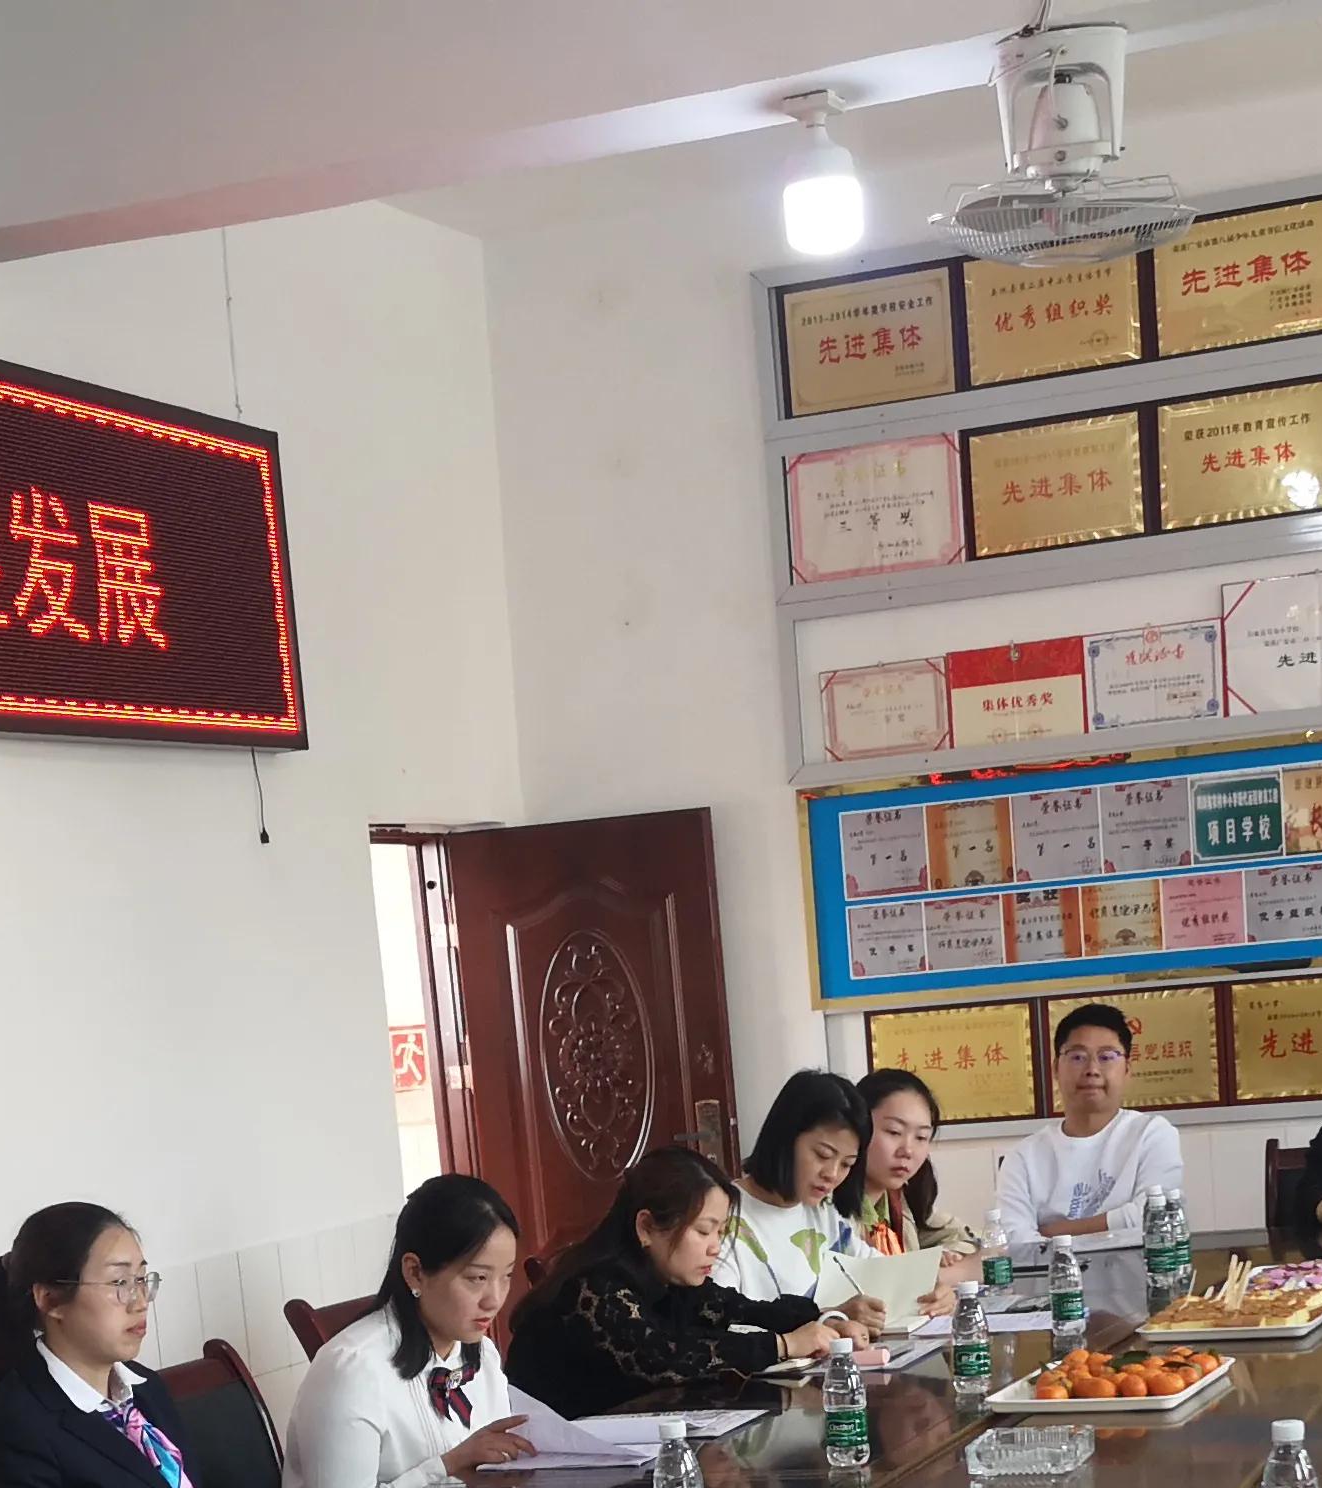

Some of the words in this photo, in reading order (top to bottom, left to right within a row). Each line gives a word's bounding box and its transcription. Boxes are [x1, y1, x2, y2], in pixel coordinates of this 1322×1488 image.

[1181, 249, 1312, 297] 先进集体
[995, 293, 1113, 333] 优秀组织奖
[819, 324, 922, 364] 先进集体
[1201, 440, 1296, 474] 先进集体
[1002, 468, 1113, 505] 先进集体
[1207, 814, 1271, 845] 项目学校
[895, 1041, 1010, 1073] 先进集体
